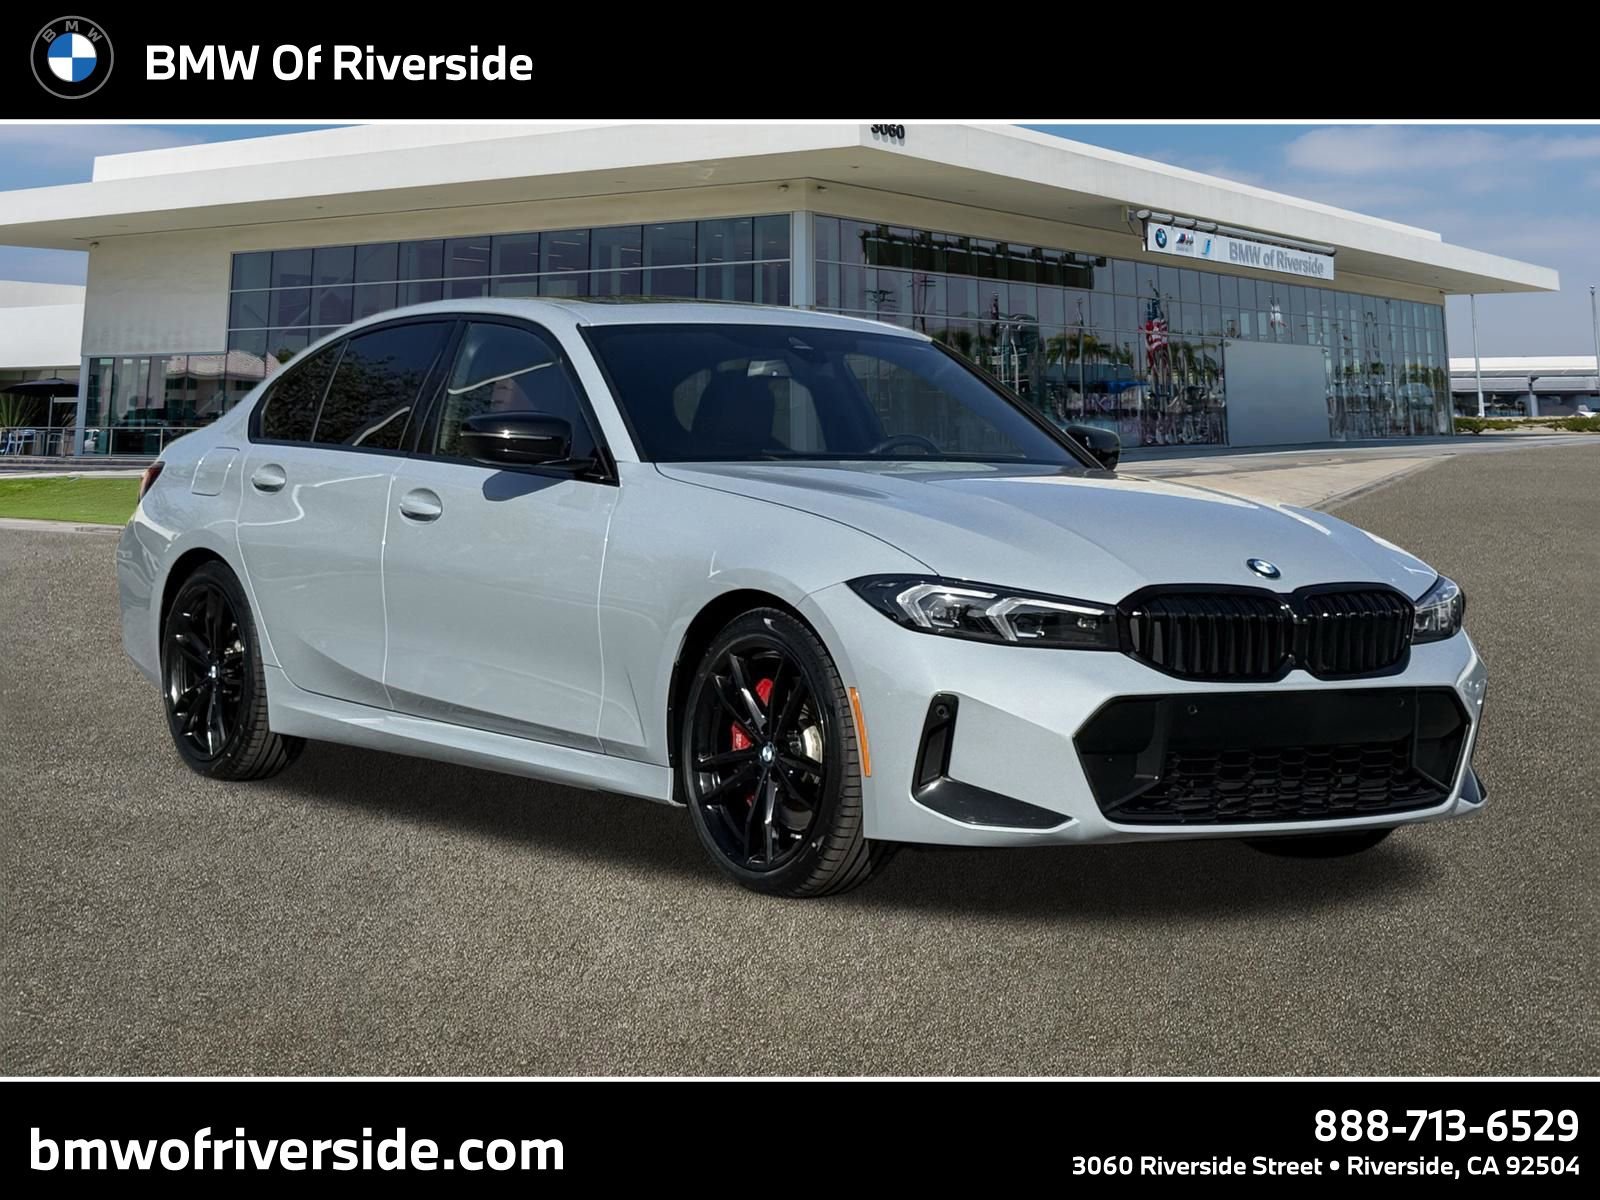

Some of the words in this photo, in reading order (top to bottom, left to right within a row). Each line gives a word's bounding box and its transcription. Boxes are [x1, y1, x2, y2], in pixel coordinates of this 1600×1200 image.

[1229, 241, 1261, 264] BMW
[1263, 249, 1275, 267] of
[1276, 251, 1324, 274] Riverside
